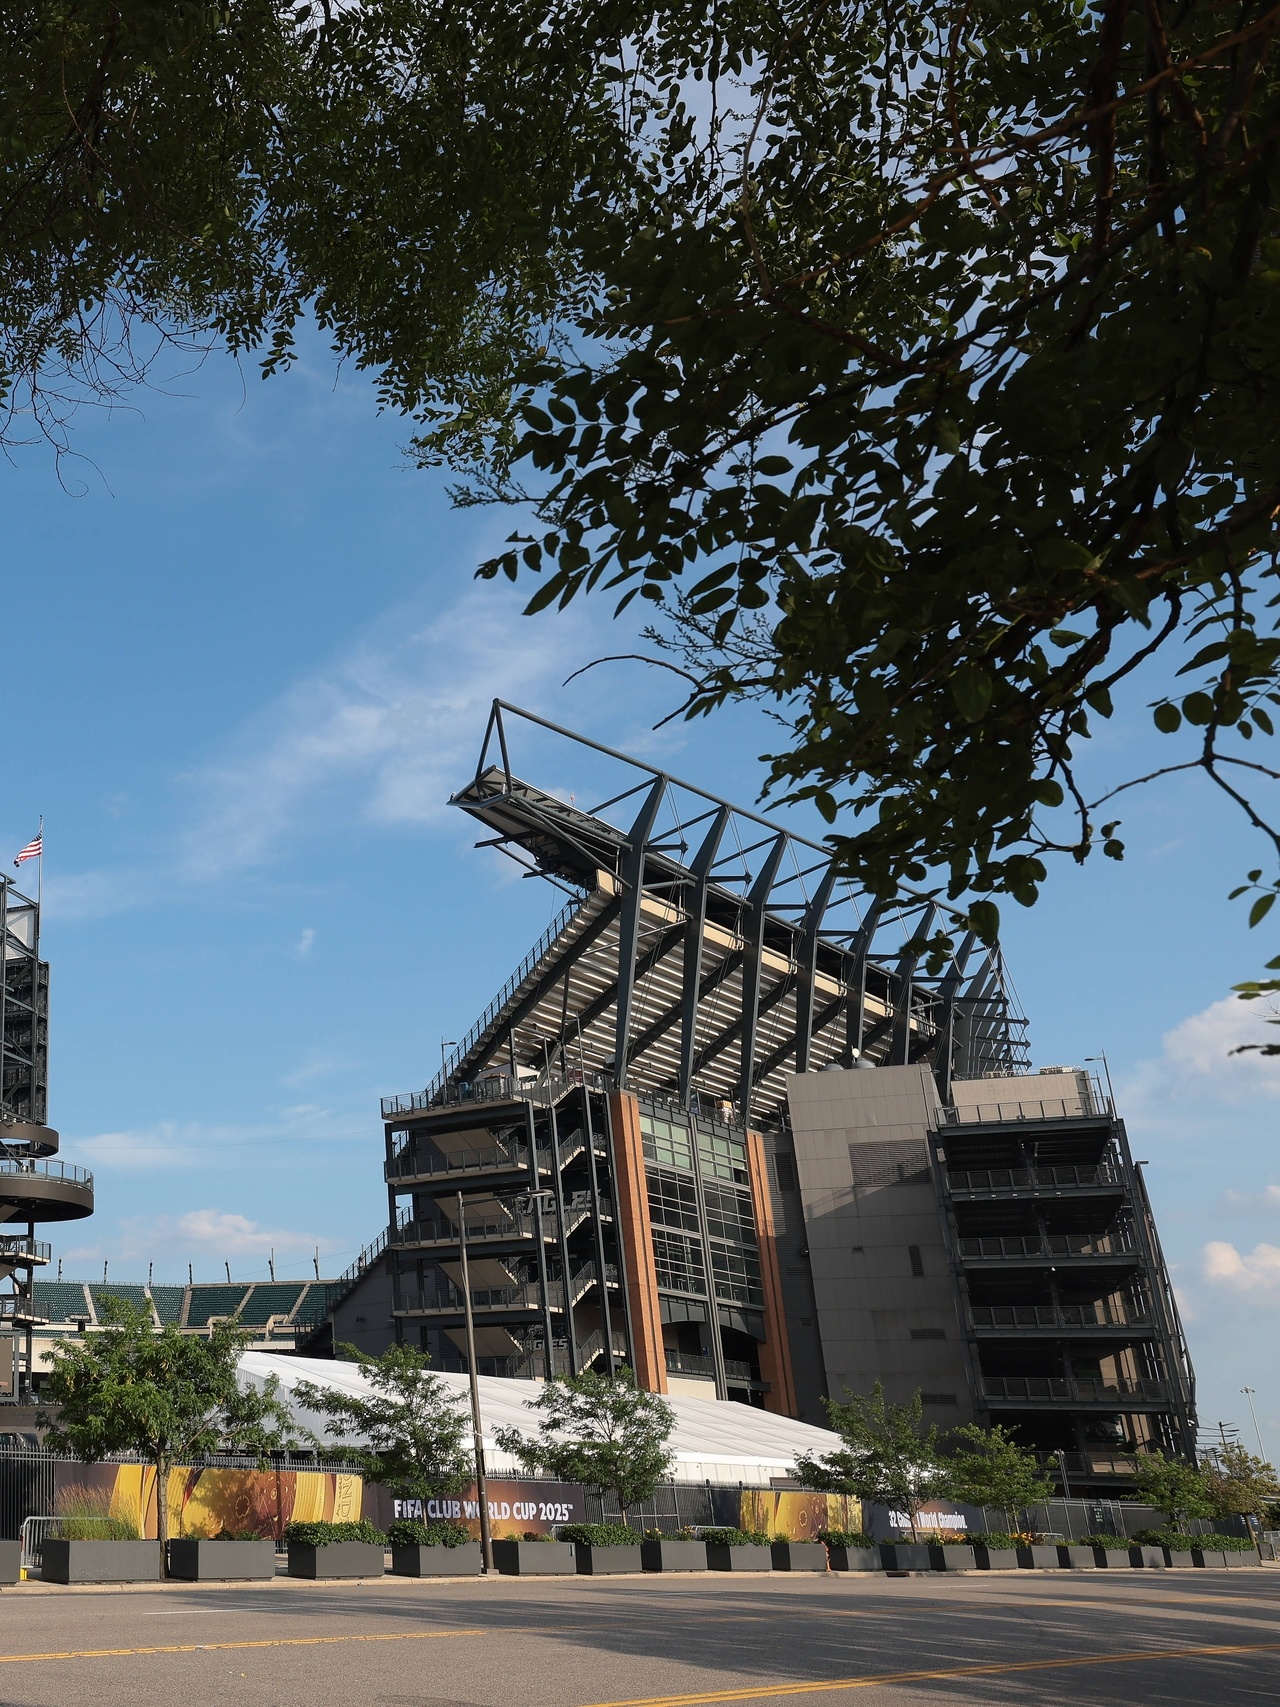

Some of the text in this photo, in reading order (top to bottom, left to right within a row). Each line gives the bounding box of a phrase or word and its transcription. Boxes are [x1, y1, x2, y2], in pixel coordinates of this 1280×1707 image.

[520, 1338, 568, 1351] AGLES
[393, 1499, 422, 1519] FIFA
[427, 1500, 462, 1519] CLUB
[463, 1501, 511, 1521] WRLD
[512, 1502, 537, 1520] CUP
[888, 1510, 898, 1528] 32
[920, 1511, 938, 1528] World
[938, 1511, 968, 1530] Champion.
